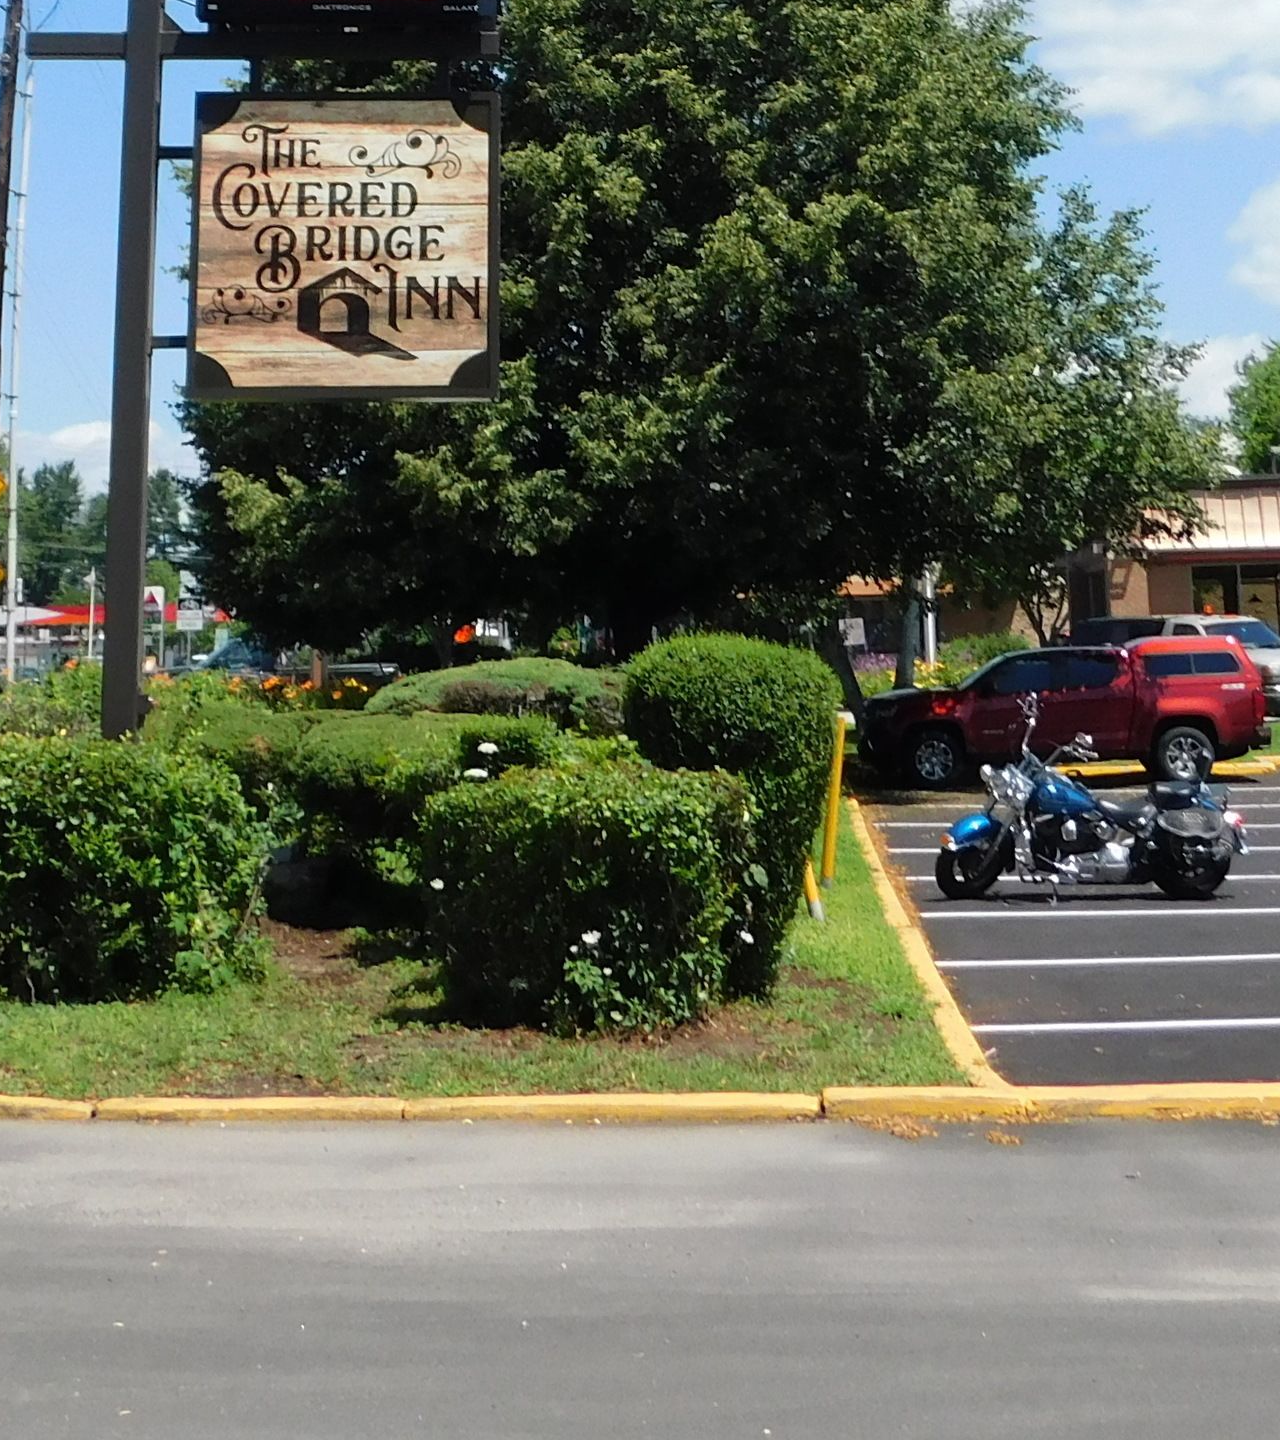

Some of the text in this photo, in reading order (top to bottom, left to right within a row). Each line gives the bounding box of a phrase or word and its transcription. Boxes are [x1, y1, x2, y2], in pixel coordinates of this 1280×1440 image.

[241, 123, 322, 178] THE
[211, 162, 419, 231] COVERED
[254, 224, 446, 293] BRIDGE
[373, 262, 482, 333] INN
